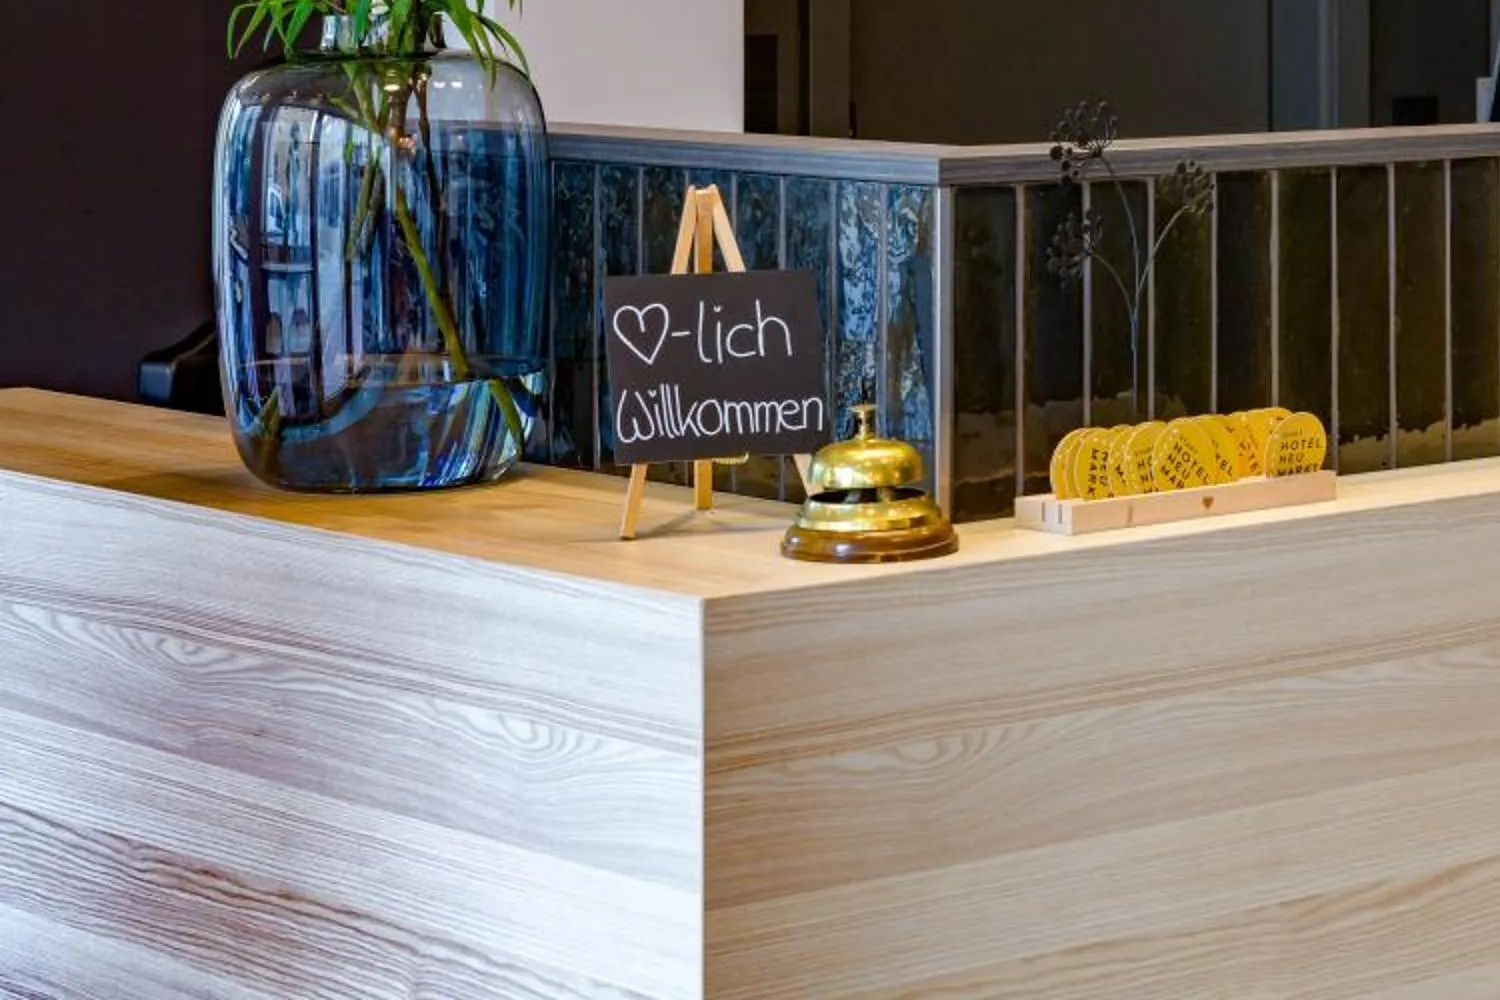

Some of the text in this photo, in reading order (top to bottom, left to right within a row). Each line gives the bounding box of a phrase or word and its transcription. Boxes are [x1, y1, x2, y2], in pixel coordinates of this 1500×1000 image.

[616, 383, 824, 443] Willkommen
[1281, 438, 1324, 450] HOTEL
[1168, 453, 1191, 480] NEU
[1173, 441, 1209, 485] HOTEL
[1280, 452, 1305, 464] NEU
[1087, 447, 1100, 497] MARK
[1161, 465, 1185, 489] MAR
